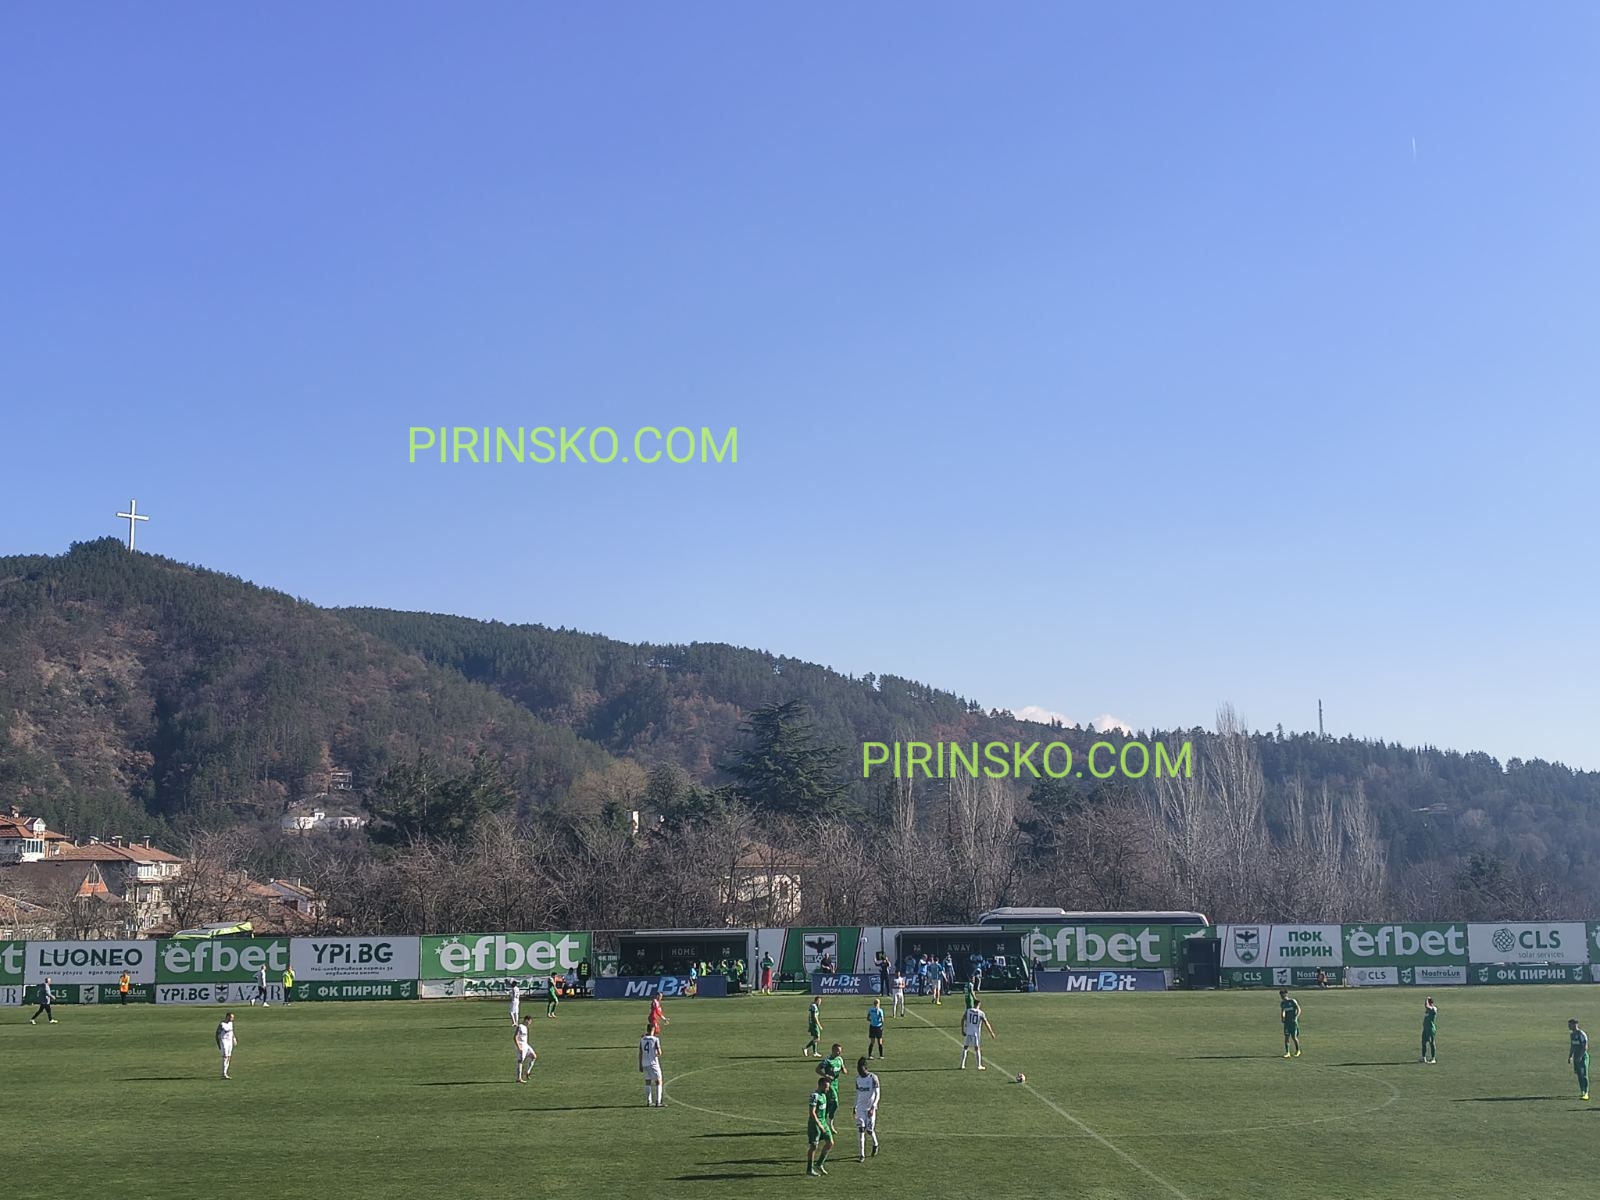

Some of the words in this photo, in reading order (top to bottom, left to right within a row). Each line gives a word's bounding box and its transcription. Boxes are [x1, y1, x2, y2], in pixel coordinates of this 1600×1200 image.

[1288, 931, 1322, 942] ПФК
[1349, 925, 1465, 957] efbet
[1518, 930, 1562, 949] CLS
[946, 943, 971, 952] AWAY
[1022, 926, 1161, 963] efbet
[40, 948, 143, 967] LUONEO
[164, 940, 287, 973] efbet
[439, 934, 580, 973] efbet
[671, 947, 696, 956] HOME
[1280, 946, 1333, 957] ПИРИН
[1518, 951, 1535, 959] solar
[820, 974, 861, 987] MrBit
[1243, 972, 1262, 981] CLS
[1368, 971, 1387, 980] CLS
[1496, 969, 1516, 979] ФК
[1520, 969, 1566, 980] ПИРИН
[1066, 972, 1136, 991] MrBit
[317, 986, 338, 997] ФК
[342, 985, 392, 997] ПИРИН
[969, 1013, 979, 1024] 10
[643, 1041, 650, 1055] 4
